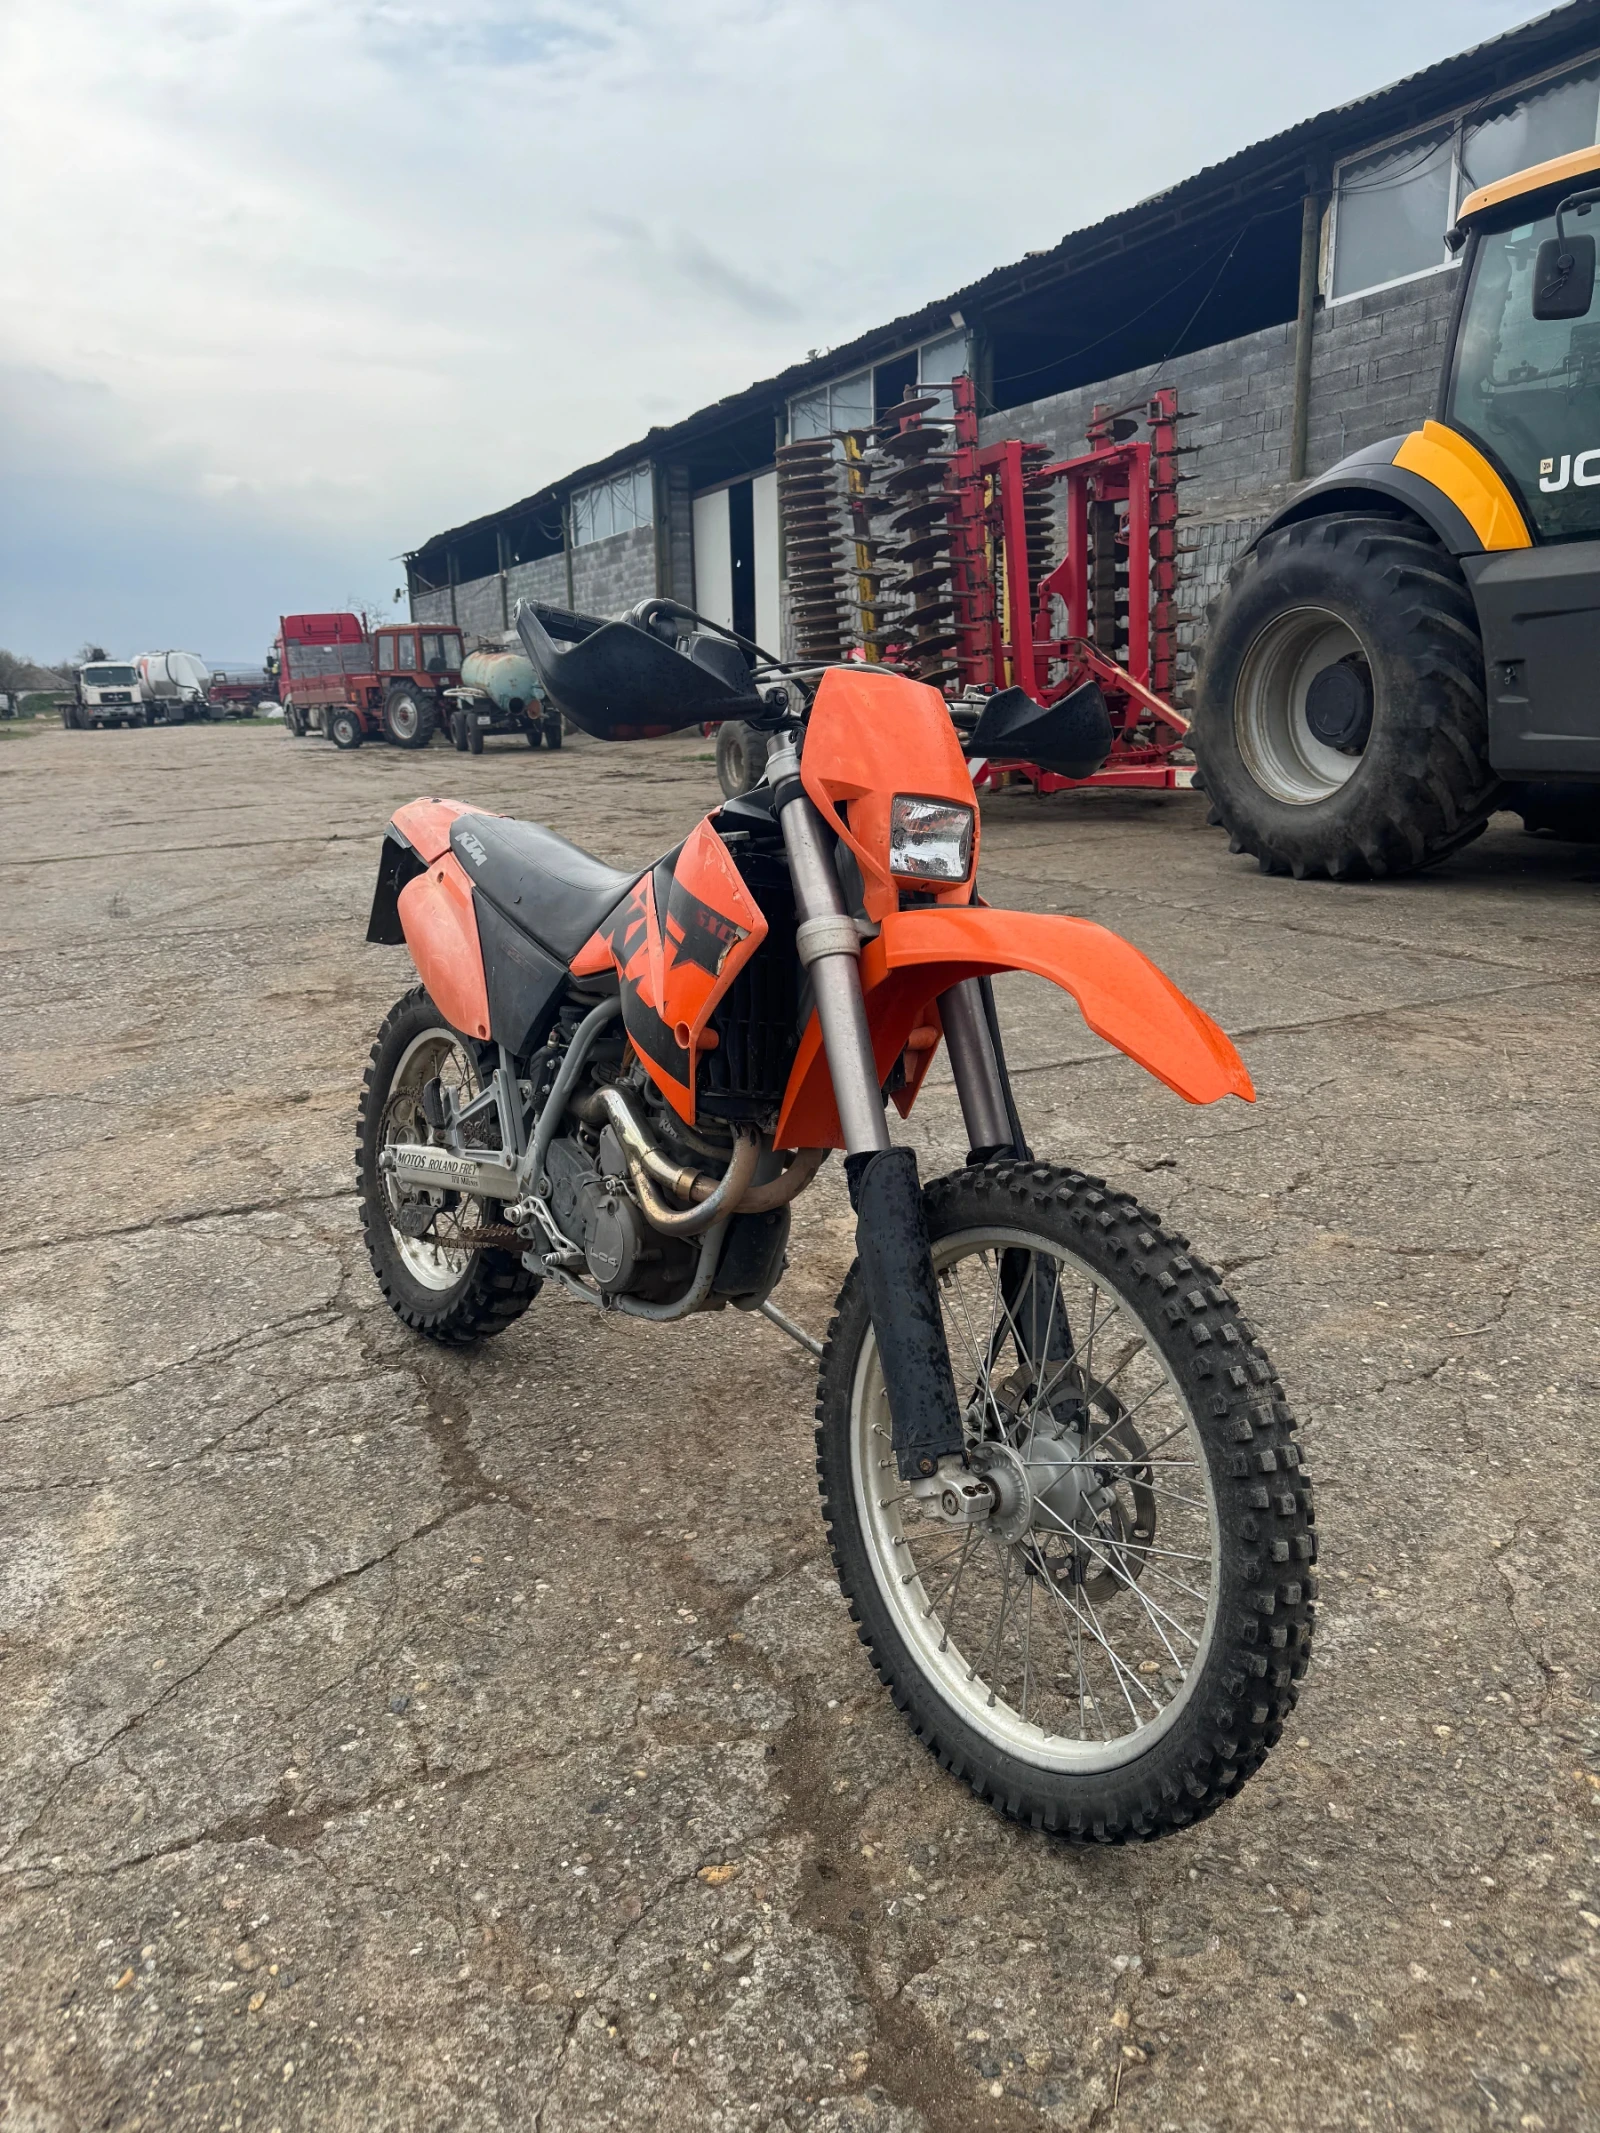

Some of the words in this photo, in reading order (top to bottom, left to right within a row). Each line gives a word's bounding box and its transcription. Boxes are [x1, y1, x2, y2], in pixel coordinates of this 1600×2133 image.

[454, 831, 488, 867] KTM
[658, 1118, 678, 1138] KTM
[398, 1153, 426, 1168] MOTOS
[429, 1159, 458, 1173] ROLAND
[459, 1163, 477, 1175] FREY
[590, 1246, 618, 1267] LC4
